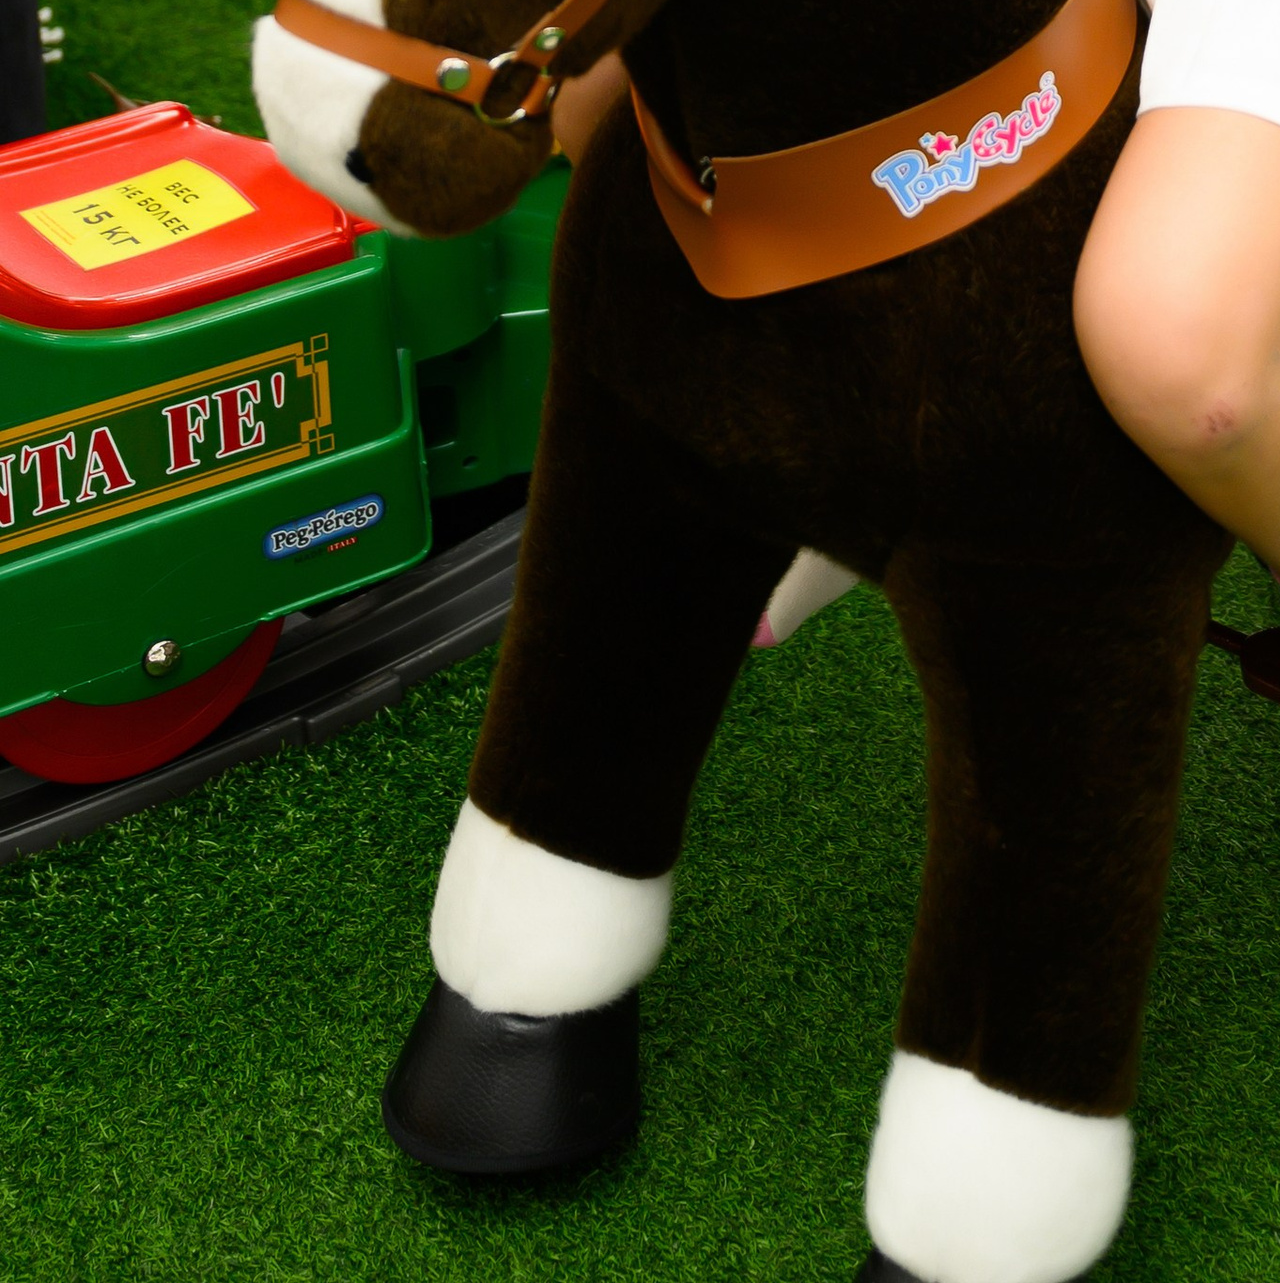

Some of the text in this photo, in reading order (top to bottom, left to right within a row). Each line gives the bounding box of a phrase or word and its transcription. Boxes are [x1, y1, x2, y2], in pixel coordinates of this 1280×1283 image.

[873, 87, 1060, 216] PonyCycle
[116, 184, 190, 235] НЕ БОЛЕЕ
[164, 182, 200, 204] ВЕС
[72, 203, 114, 225] 15
[100, 225, 141, 246] КГ
[329, 537, 357, 552] ITALY
